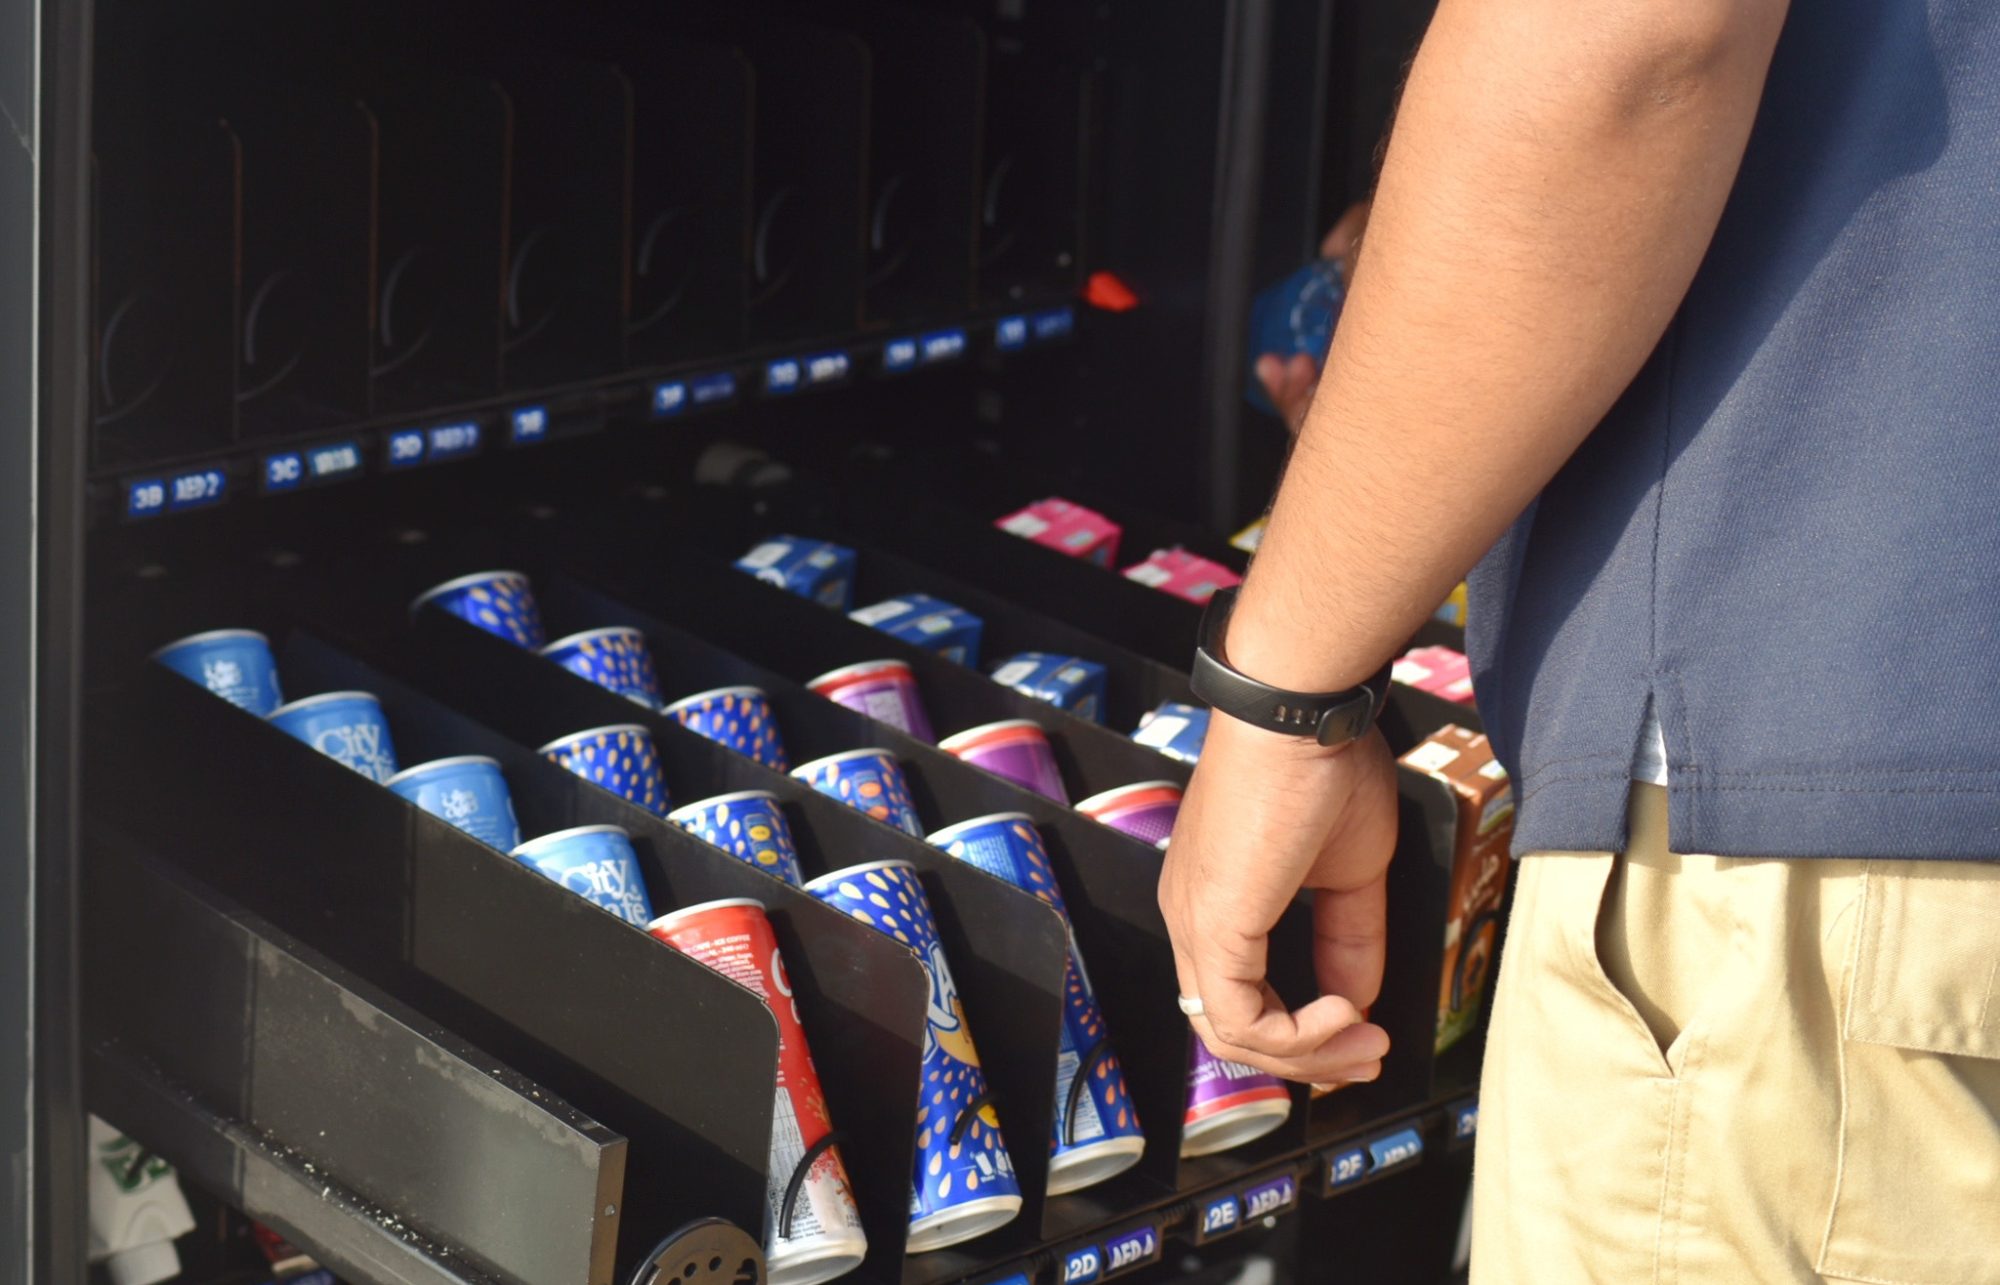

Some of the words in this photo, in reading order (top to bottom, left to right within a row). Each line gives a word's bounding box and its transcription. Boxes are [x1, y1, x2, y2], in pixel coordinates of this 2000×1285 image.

[313, 724, 380, 760] City
[561, 860, 628, 899] City
[1210, 1202, 1235, 1230] 2E
[1069, 1253, 1097, 1280] 2D
